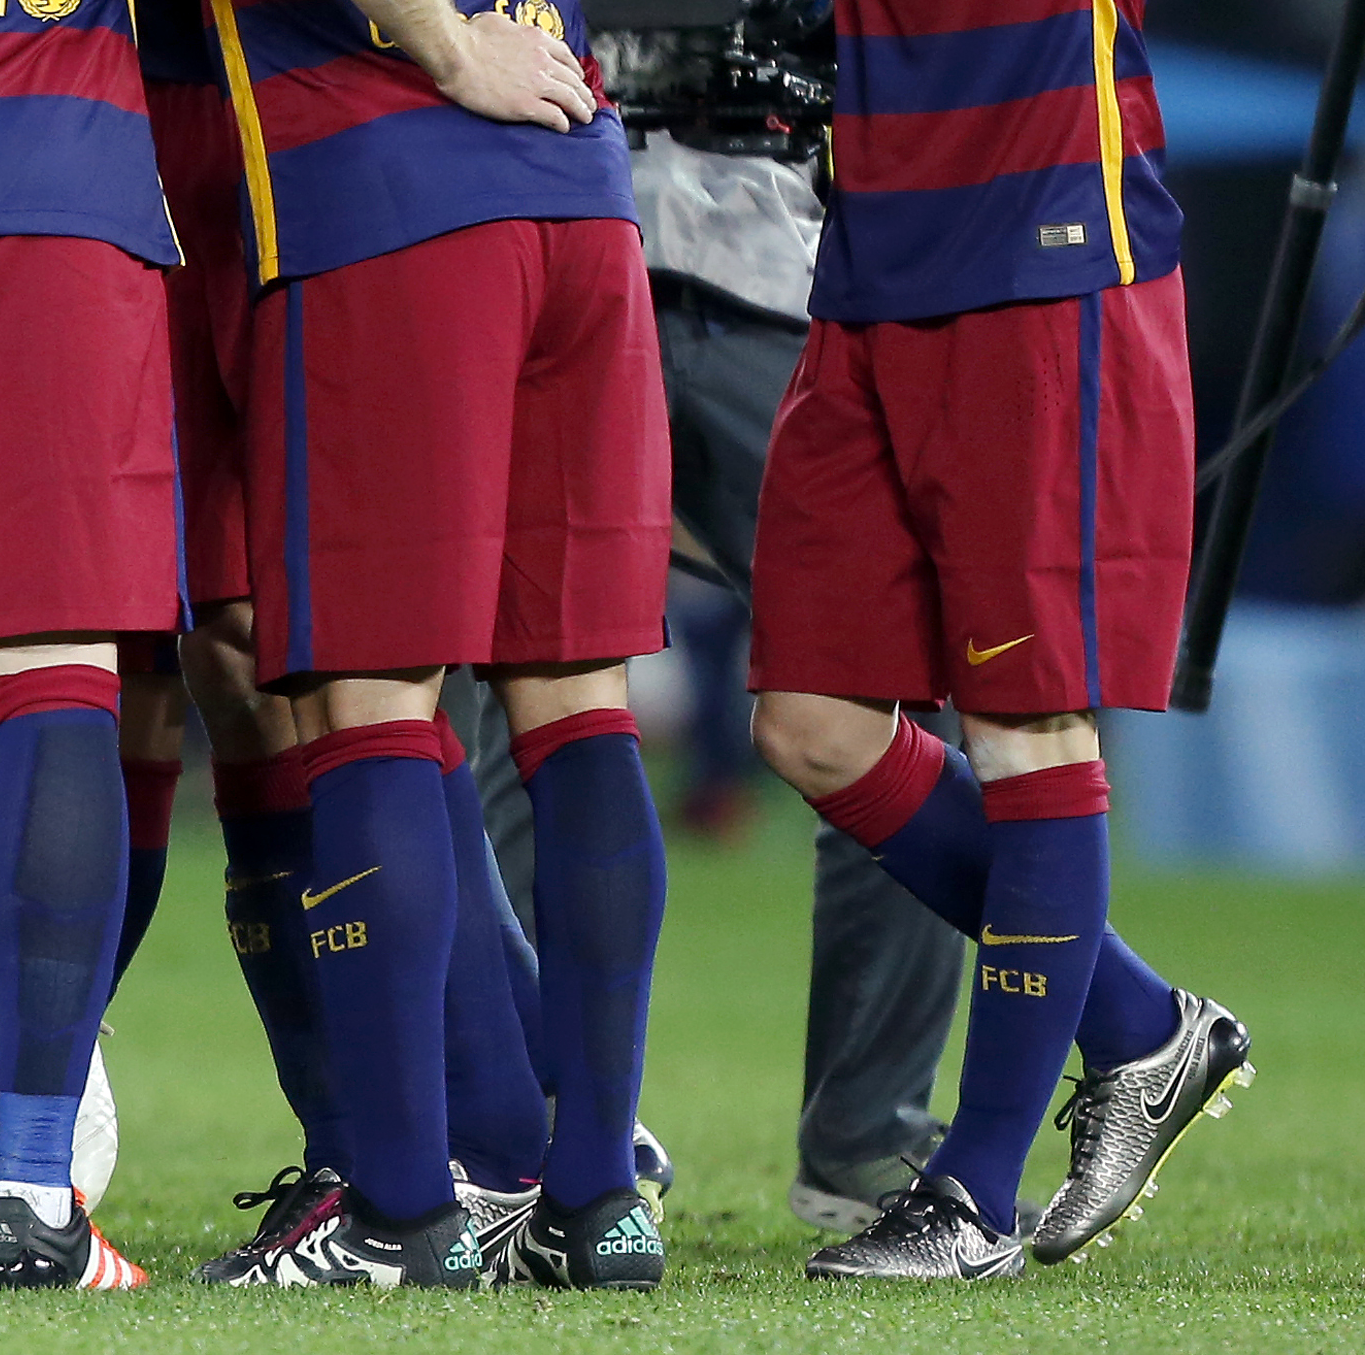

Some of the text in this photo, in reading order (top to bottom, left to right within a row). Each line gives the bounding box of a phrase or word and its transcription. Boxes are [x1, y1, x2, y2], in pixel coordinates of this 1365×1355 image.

[228, 920, 271, 955] CB
[311, 921, 368, 959] FCB
[981, 965, 1047, 998] FCB
[444, 1250, 483, 1271] adid
[596, 1235, 664, 1256] adidas
